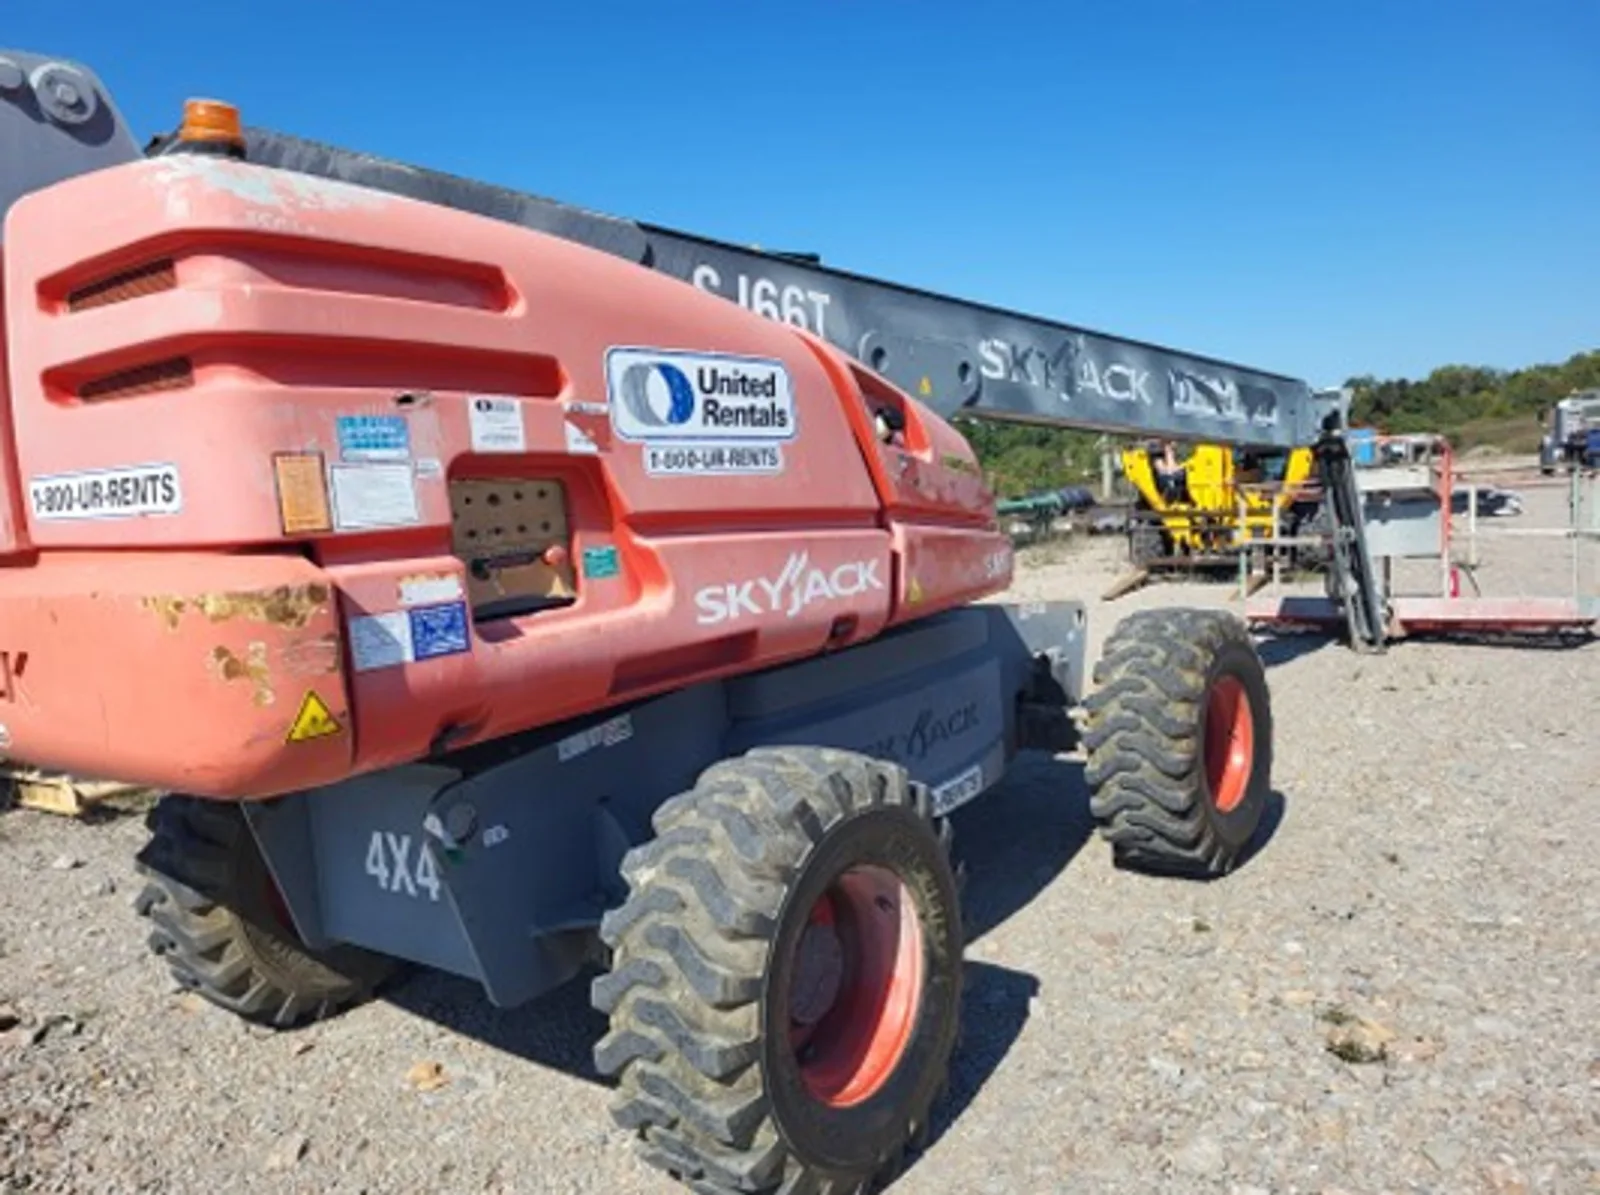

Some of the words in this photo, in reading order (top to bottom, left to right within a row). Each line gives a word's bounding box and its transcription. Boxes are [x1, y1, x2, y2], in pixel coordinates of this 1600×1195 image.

[698, 367, 776, 398] United
[979, 335, 1152, 406] SKYJACK
[702, 400, 788, 428] Rentals
[33, 472, 176, 512] 1-800-UR-RENTS
[694, 549, 885, 625] SKYJACK
[365, 831, 440, 901] 4X4
